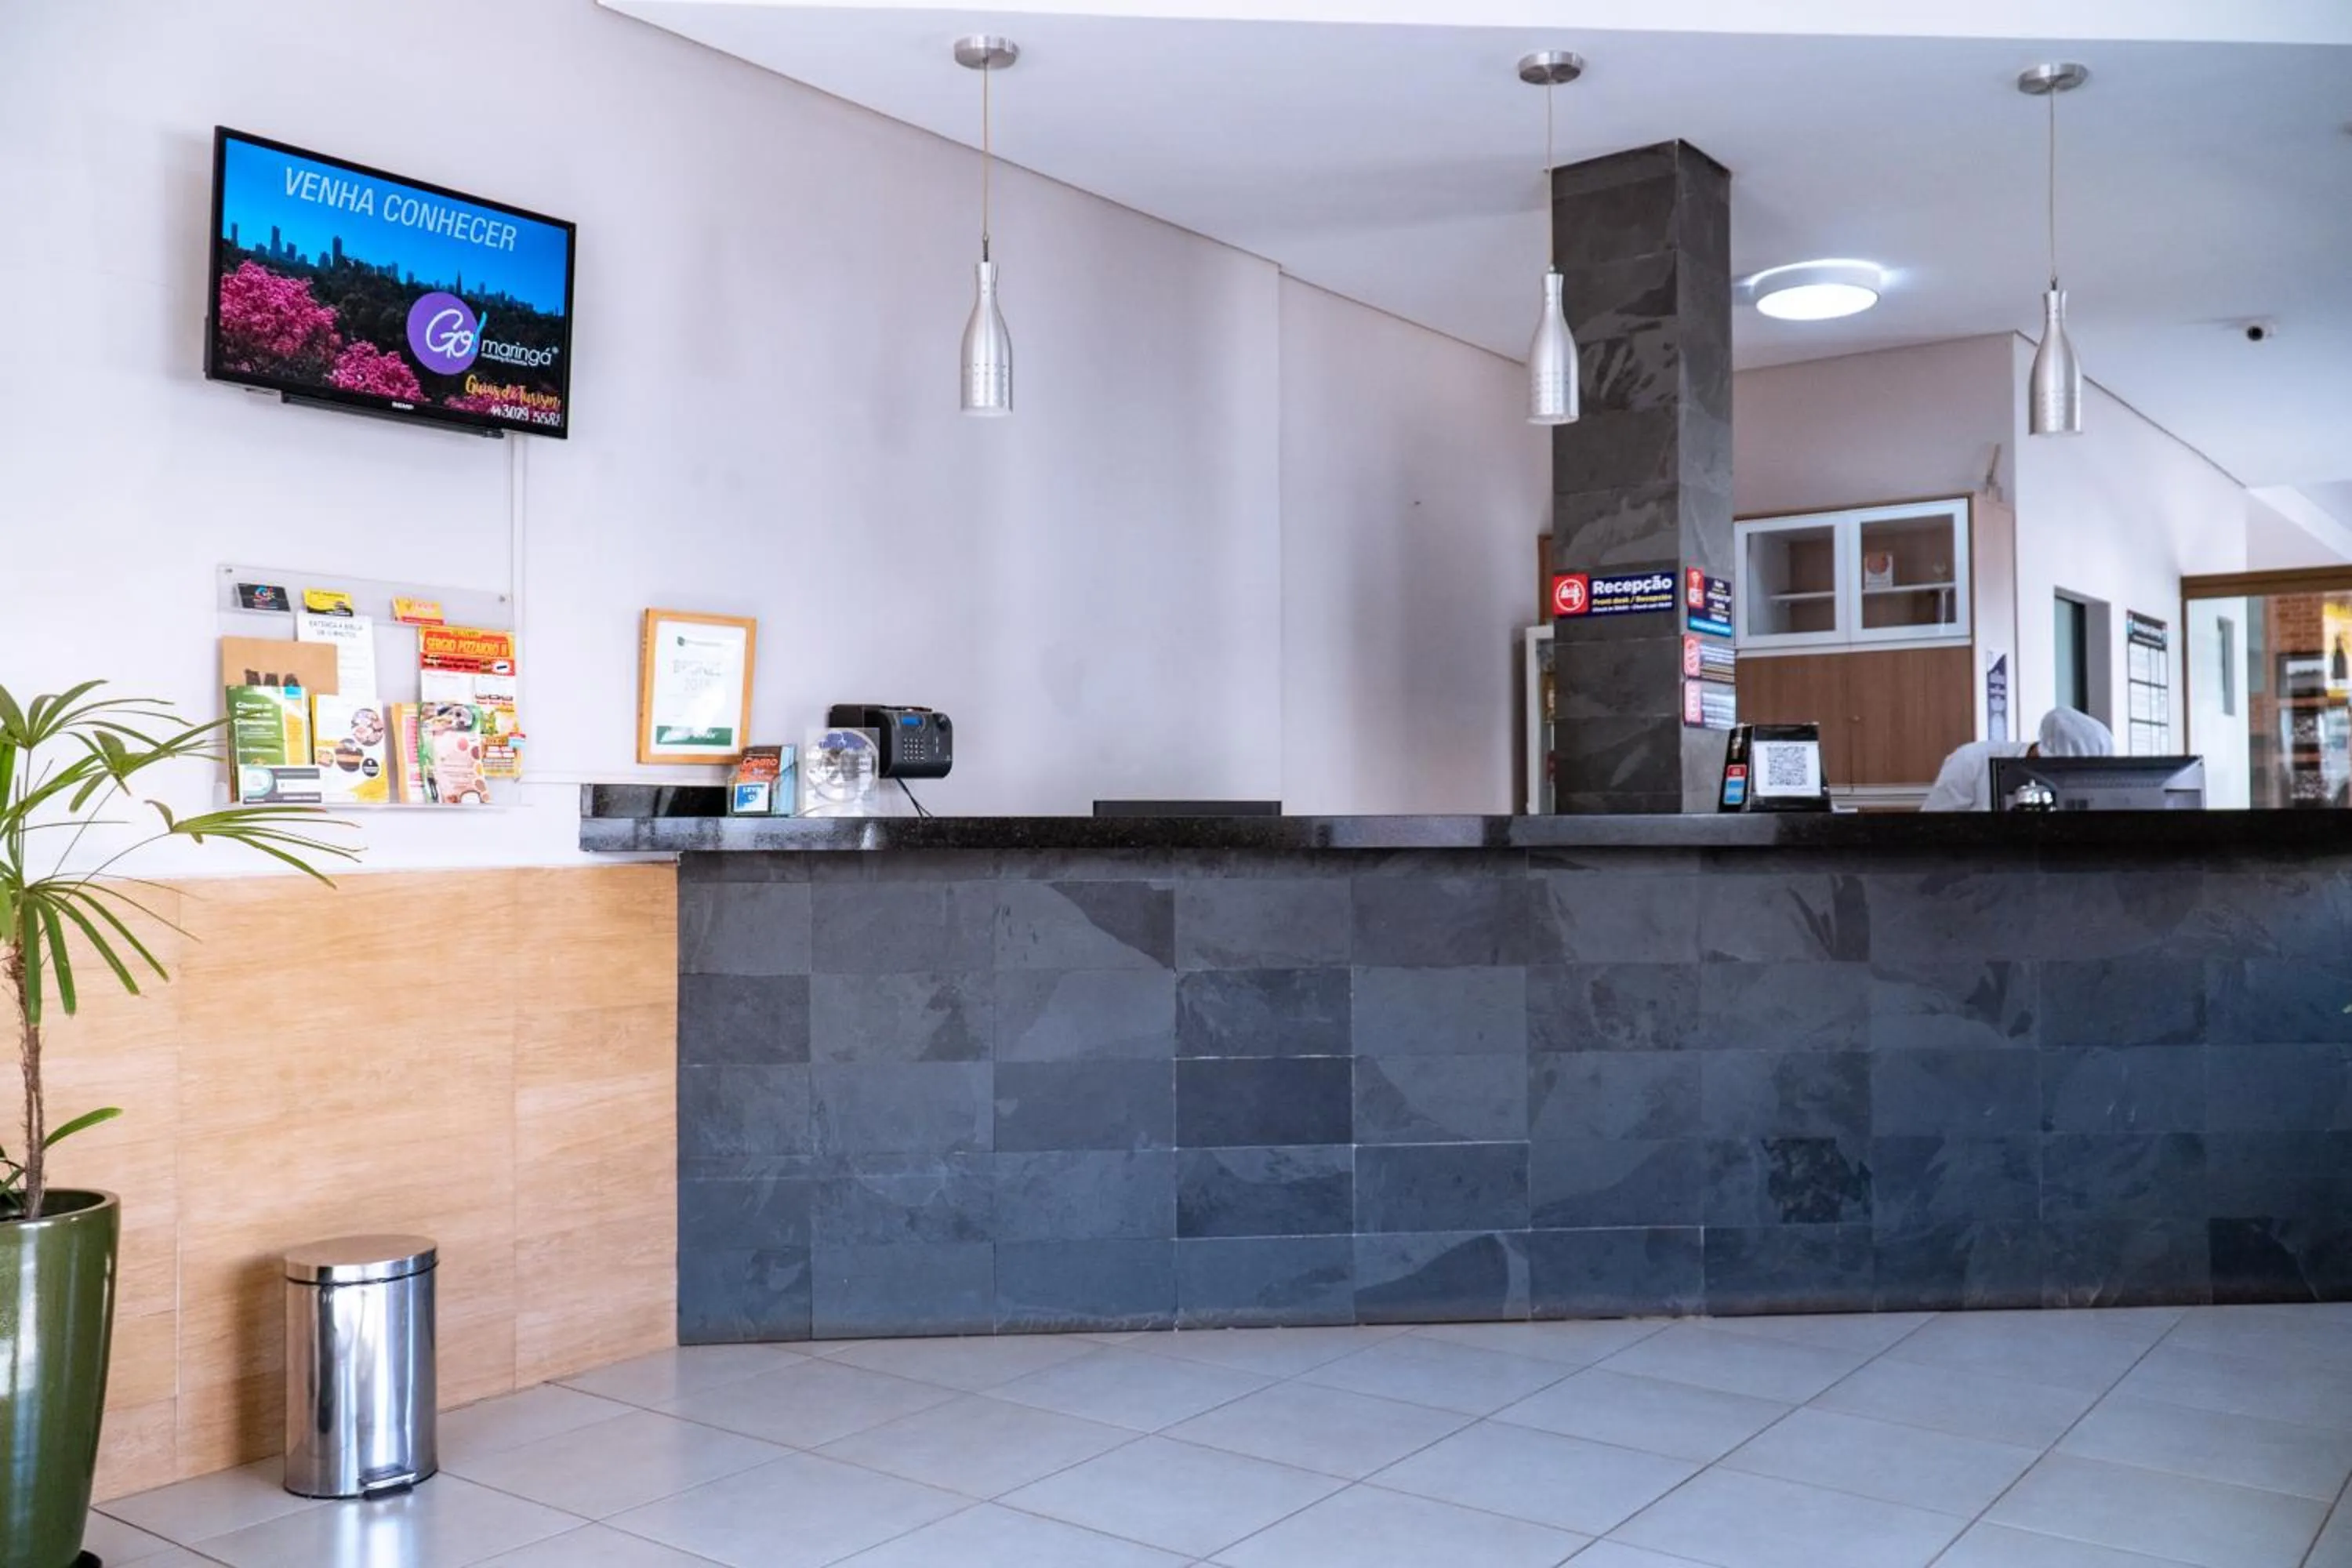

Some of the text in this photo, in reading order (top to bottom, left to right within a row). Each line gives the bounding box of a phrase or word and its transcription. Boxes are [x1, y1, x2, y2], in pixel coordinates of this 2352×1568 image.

[285, 166, 517, 252] VENHA CONHECER
[481, 339, 552, 367] maringá
[1592, 575, 1672, 594] Recepção
